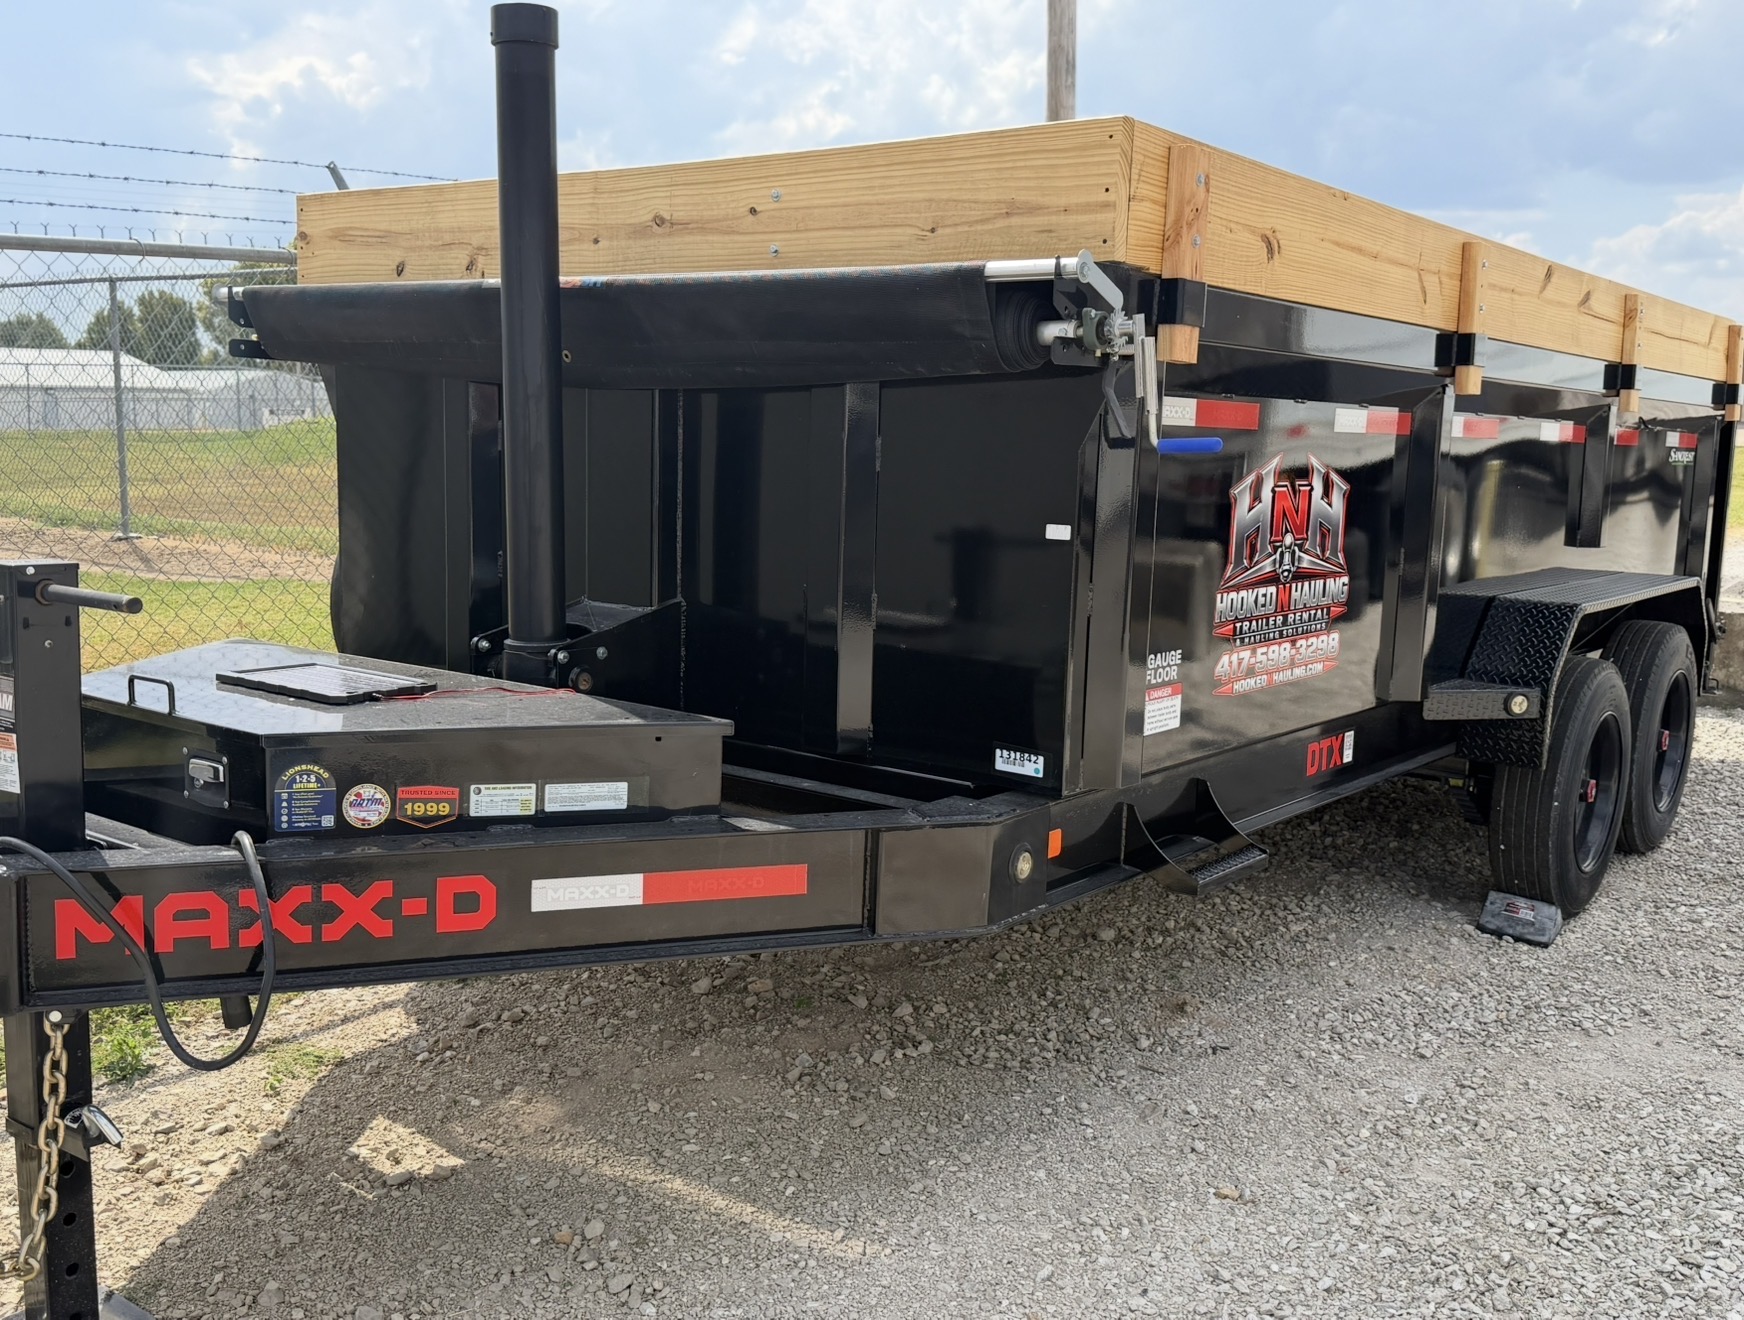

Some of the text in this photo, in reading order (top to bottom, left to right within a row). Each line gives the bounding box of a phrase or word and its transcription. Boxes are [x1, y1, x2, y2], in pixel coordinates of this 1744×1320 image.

[1214, 575, 1349, 623] HOOKED N HAULING
[1235, 607, 1329, 636] TRAILER RENTAL
[1244, 631, 1280, 646] HAULING
[1282, 622, 1327, 638] SOLUTIONS
[1147, 649, 1182, 669] GAUGE
[1214, 632, 1340, 681] 417-598-3298
[1146, 666, 1178, 685] FLOOR
[1149, 687, 1172, 700] DANGER
[999, 750, 1040, 765] 131842
[1306, 733, 1344, 777] DTX
[281, 764, 330, 781] LIONSHEAD
[404, 802, 450, 816] 1999
[547, 884, 630, 901] MAXX-D
[54, 874, 498, 960] MAXX-D
